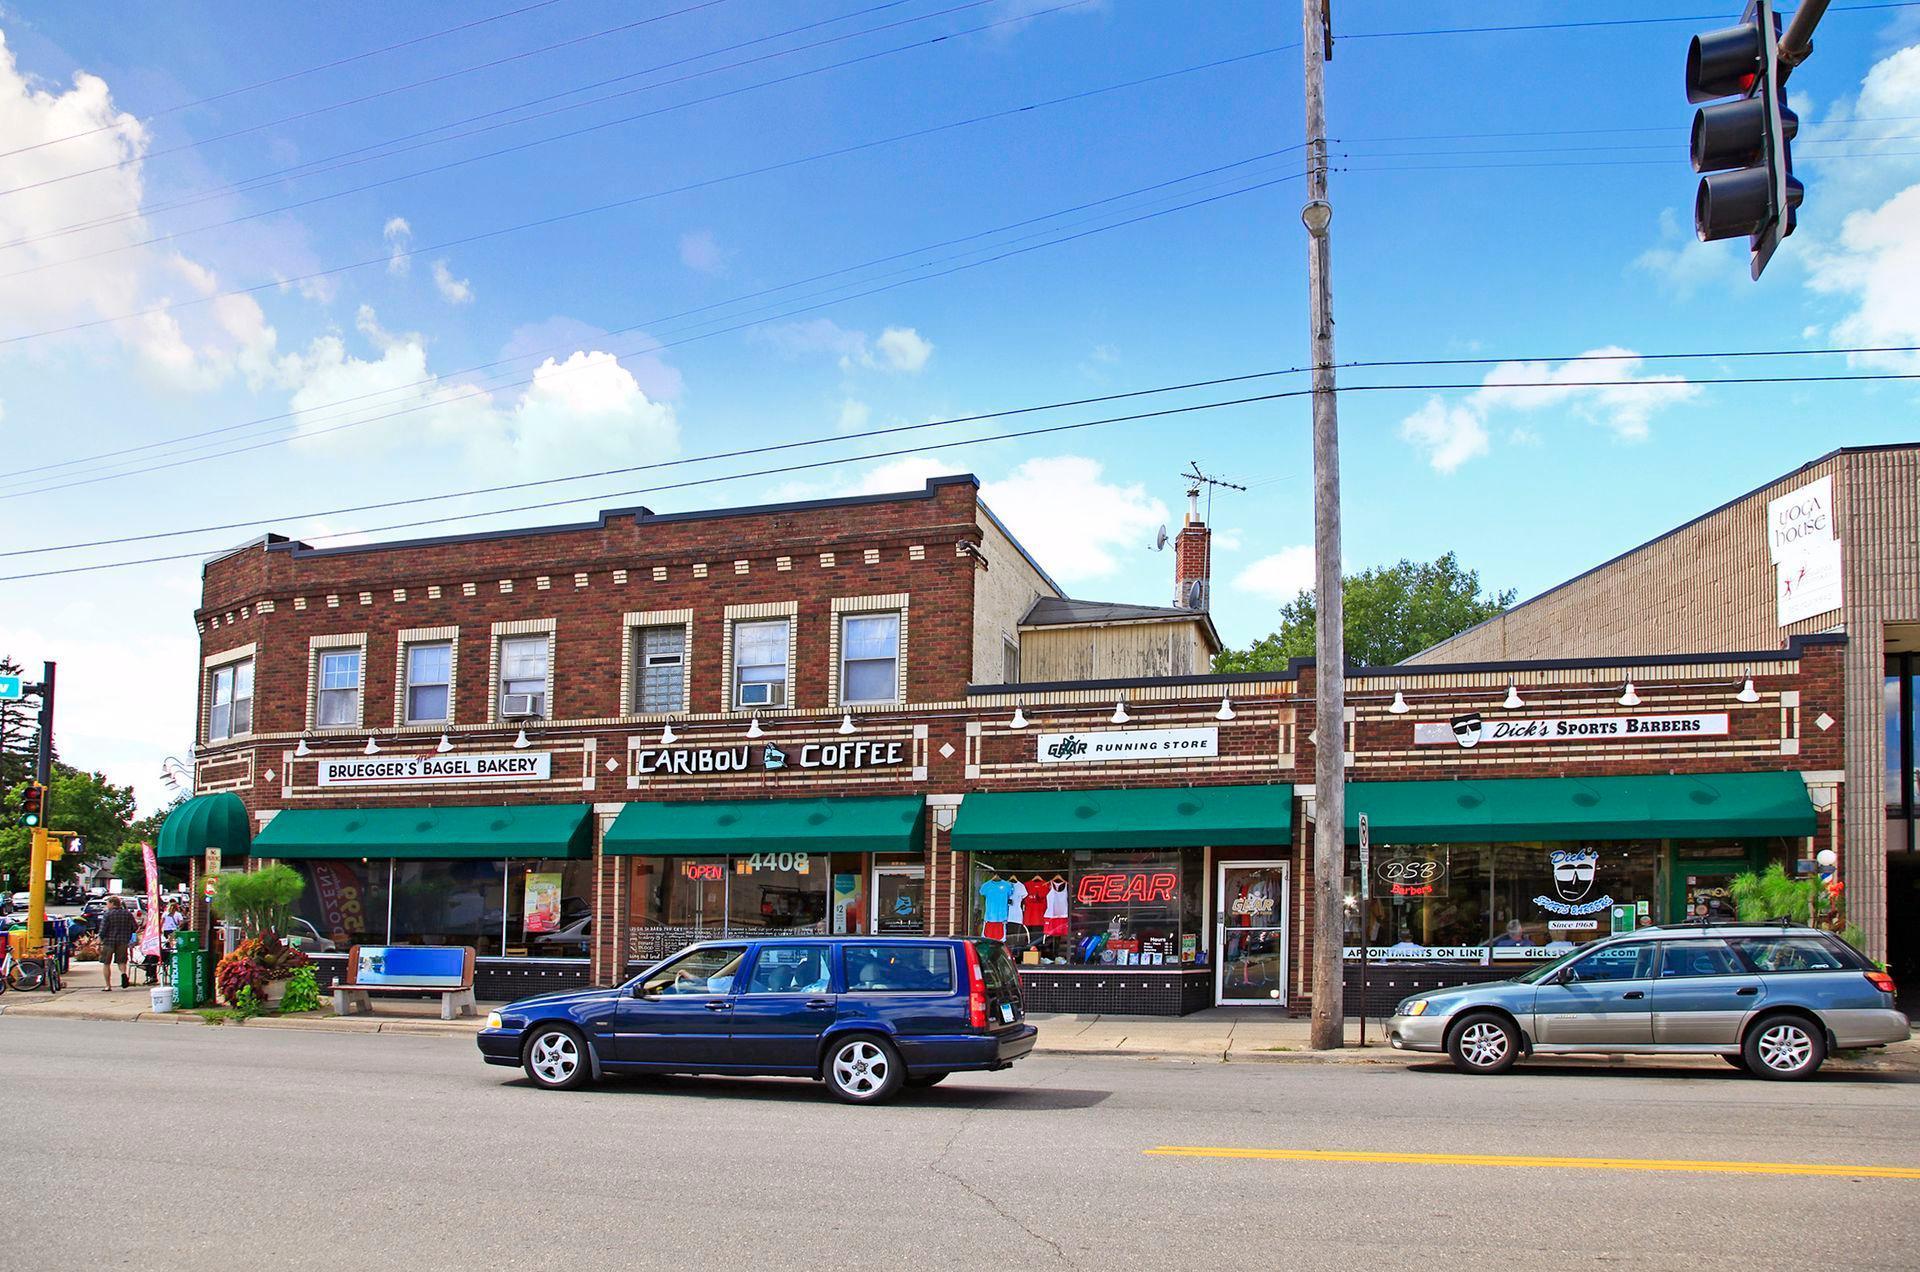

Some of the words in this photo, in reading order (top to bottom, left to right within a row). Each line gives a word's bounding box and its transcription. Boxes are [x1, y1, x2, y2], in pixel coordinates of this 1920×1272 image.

[1492, 721, 1550, 738] Dick's
[1047, 740, 1088, 757] GEAR
[1096, 742, 1158, 752] RUNNING
[1163, 740, 1208, 749] STORE
[638, 745, 749, 774] CARIBOU
[800, 742, 904, 769] COFFEE
[328, 762, 417, 778] BRUEGGER'S
[423, 760, 471, 775] BAGEL
[477, 757, 538, 773] BAKERY
[748, 852, 809, 872] 4408
[1550, 847, 1599, 865] Dick's
[688, 864, 723, 881] OPEN
[1386, 861, 1437, 879] DSB
[1076, 873, 1177, 904] GEAR
[1390, 883, 1433, 896] Barbers
[1231, 898, 1274, 912] GEAR
[1551, 921, 1574, 929] Since
[1575, 921, 1594, 929] 1968
[1347, 949, 1432, 958] APOINTMENTS
[1437, 949, 1455, 958] ON
[1459, 948, 1484, 957] LINE
